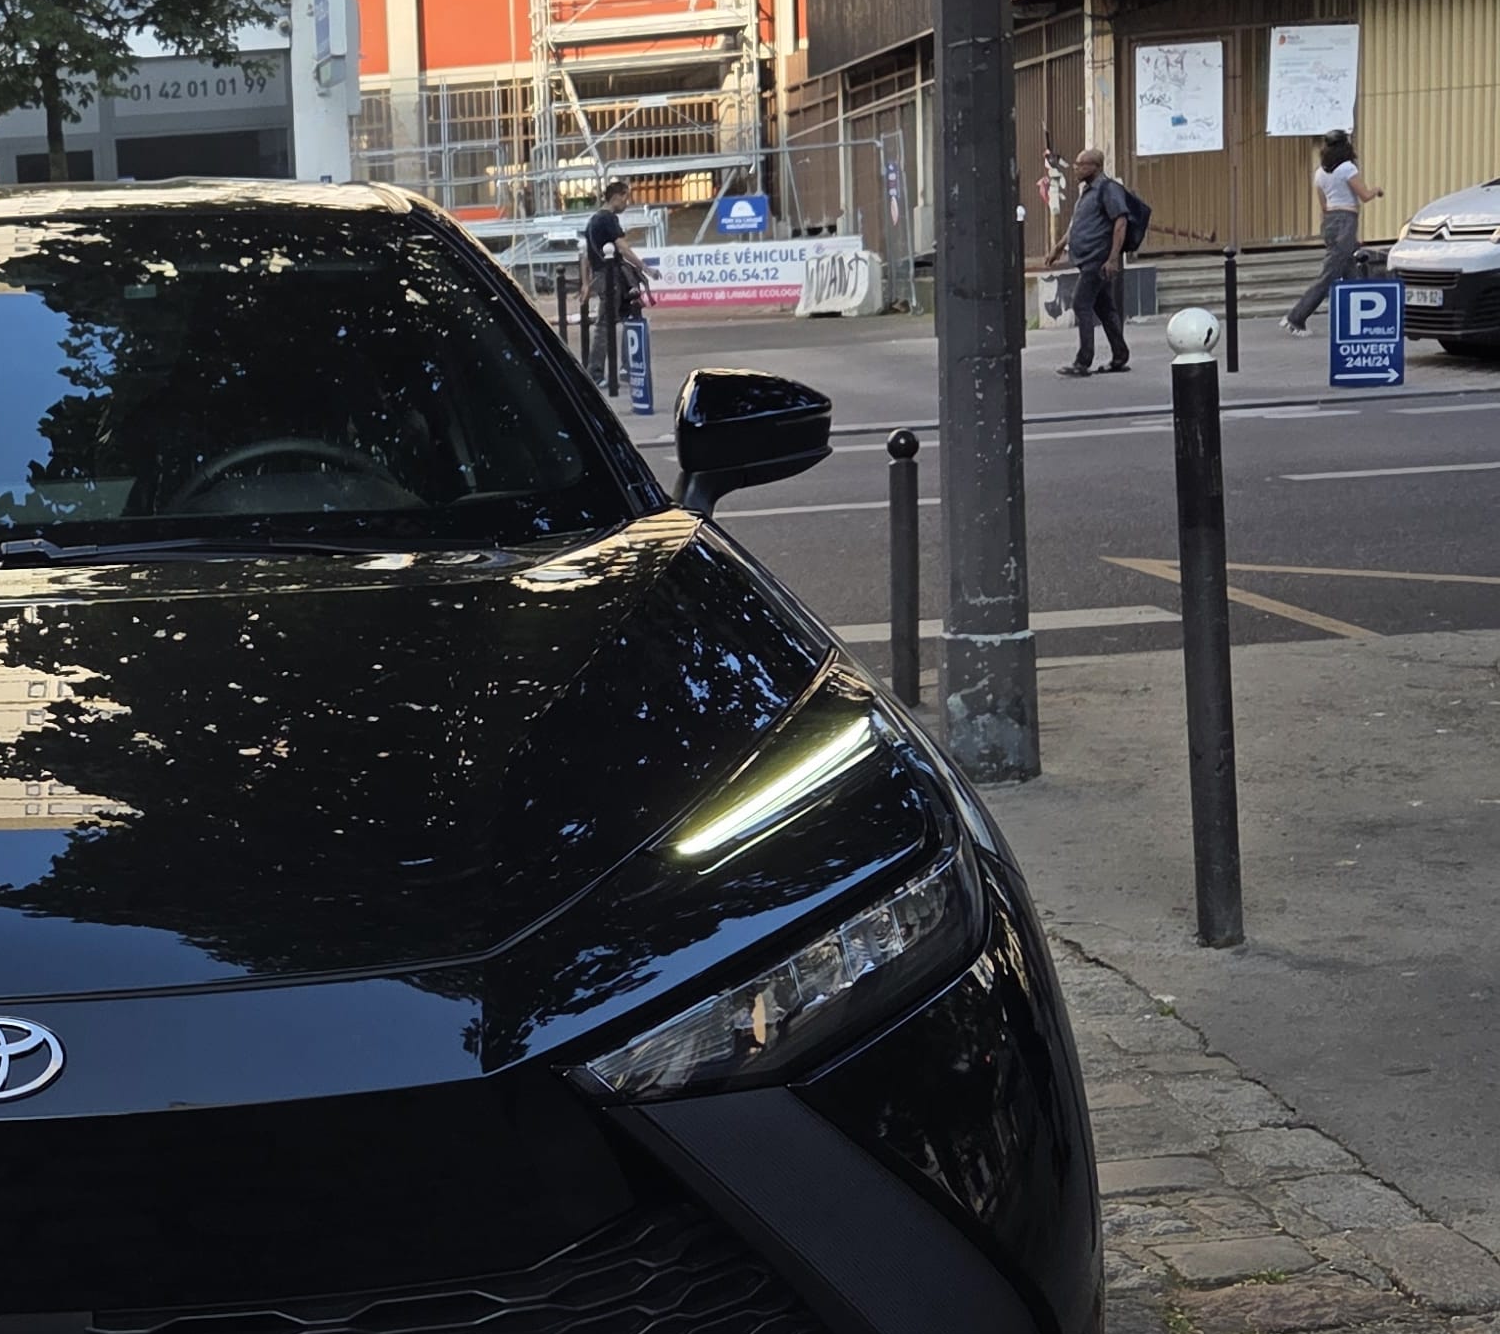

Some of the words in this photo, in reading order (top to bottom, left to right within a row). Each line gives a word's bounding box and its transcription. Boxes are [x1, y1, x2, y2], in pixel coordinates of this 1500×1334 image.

[130, 84, 151, 101] 01
[158, 81, 182, 100] 42
[187, 79, 208, 98] 01
[216, 77, 237, 96] 01
[244, 76, 267, 94] 99
[677, 249, 730, 267] ENTRÉE
[734, 247, 806, 265] VÉHICULE
[678, 266, 780, 285] 01.42.06.54.12
[1349, 291, 1387, 336] P
[1362, 326, 1395, 335] PUBLIC
[626, 329, 639, 368] P
[1339, 343, 1396, 355] OUVERT
[1345, 355, 1390, 368] 24H/24
